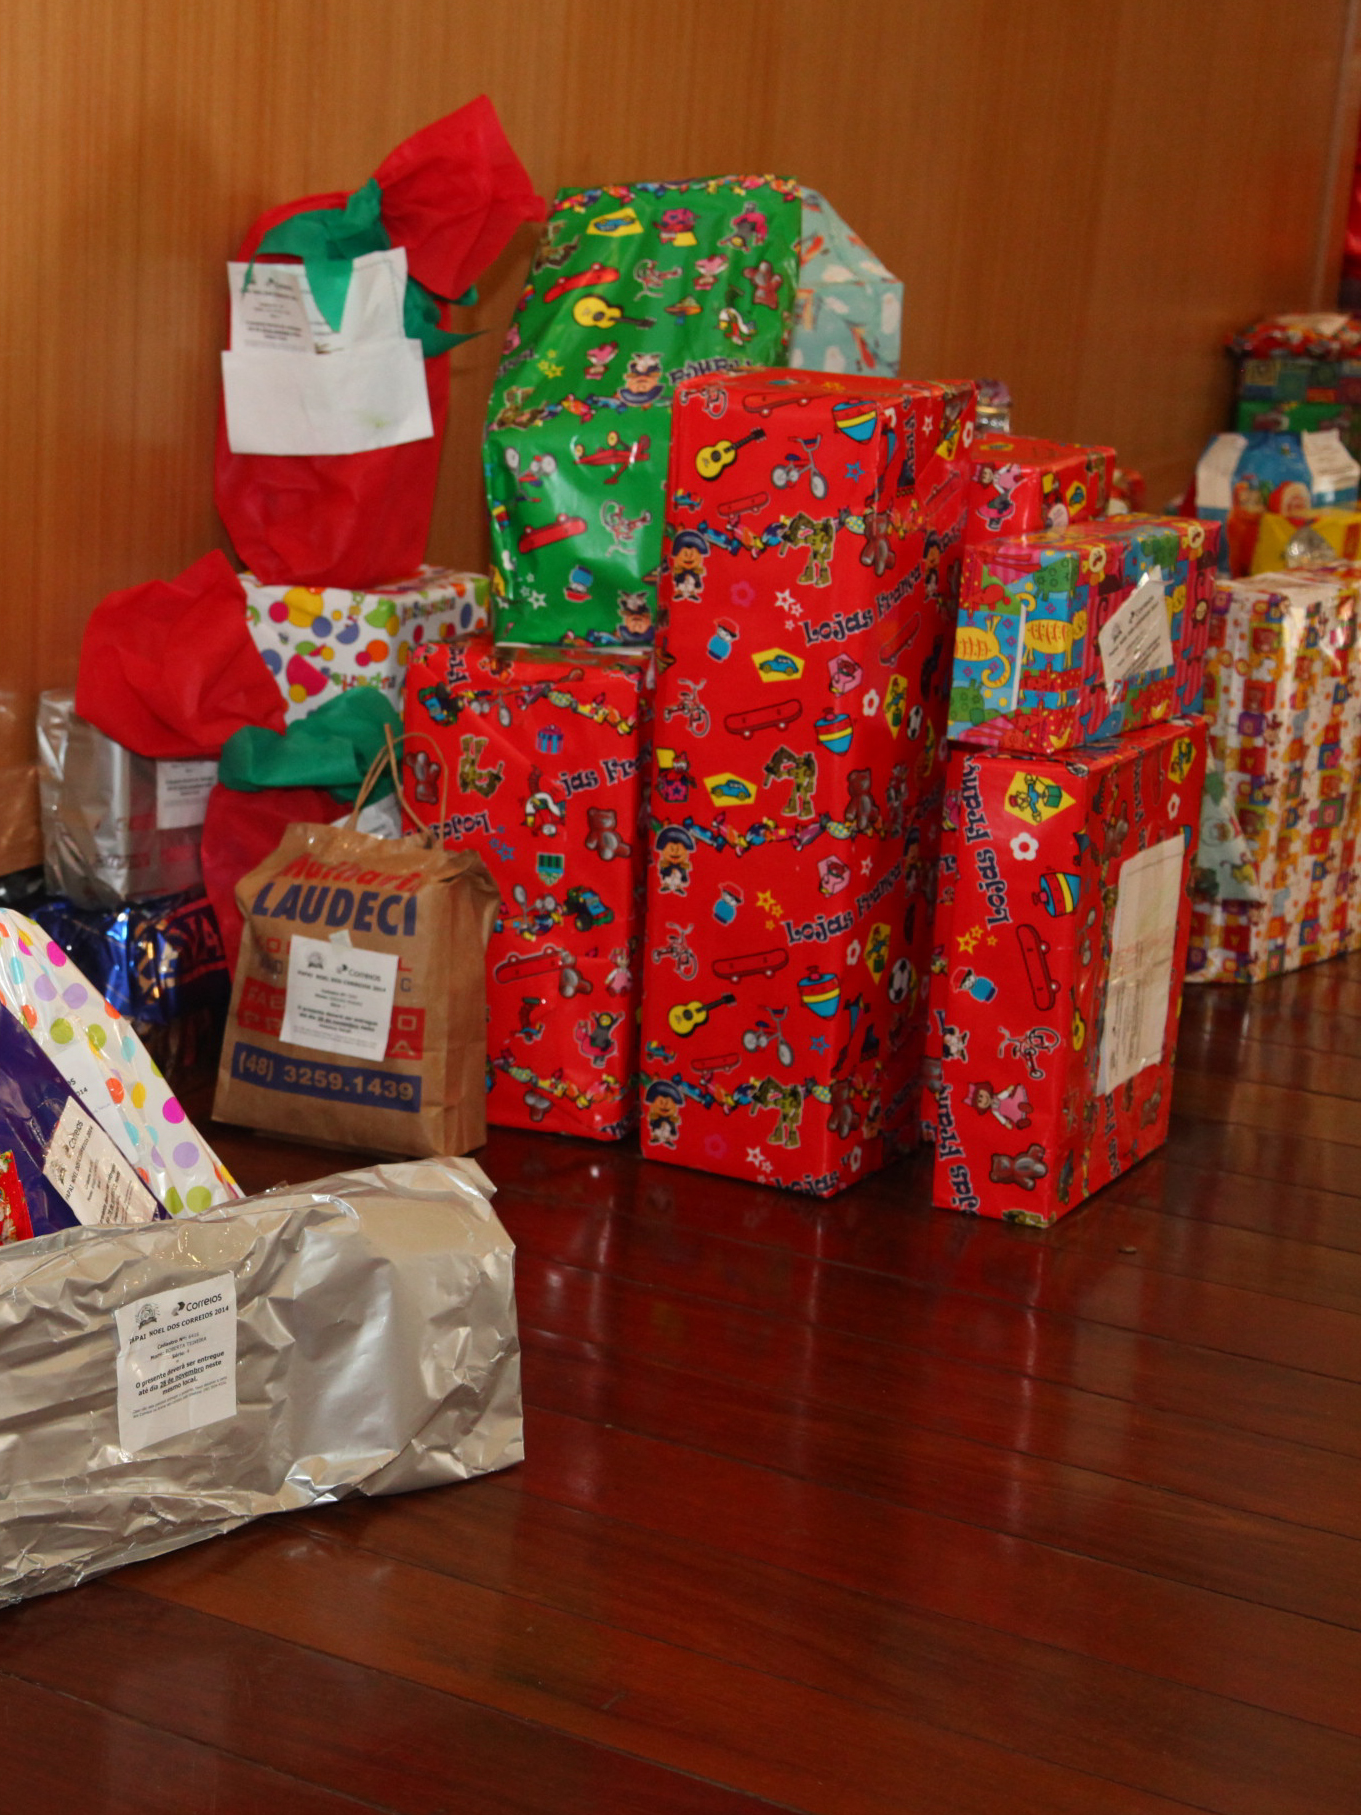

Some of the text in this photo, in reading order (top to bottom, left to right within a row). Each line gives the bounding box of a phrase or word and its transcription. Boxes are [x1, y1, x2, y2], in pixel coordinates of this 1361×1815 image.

[798, 608, 875, 647] Lojas
[556, 771, 601, 799] jas
[961, 755, 1013, 930] Lojas Franç
[252, 882, 418, 937] LAUDECI
[780, 910, 854, 946] Lojas
[239, 1050, 414, 1101] (48) 3259.1439
[186, 1291, 221, 1312] Correios
[149, 1326, 165, 1337] NOEL
[167, 1321, 179, 1331] DOS
[181, 1310, 212, 1327] CORREIOS
[214, 1305, 228, 1315] 2014
[157, 1338, 178, 1350] Cadastro
[138, 1359, 221, 1396] até dia 28 de novembro neste
[141, 1371, 166, 1387] presente
[167, 1363, 184, 1376] deverá
[186, 1359, 196, 1367] ser
[197, 1349, 224, 1364] entregue
[162, 1382, 181, 1395] mesmo
